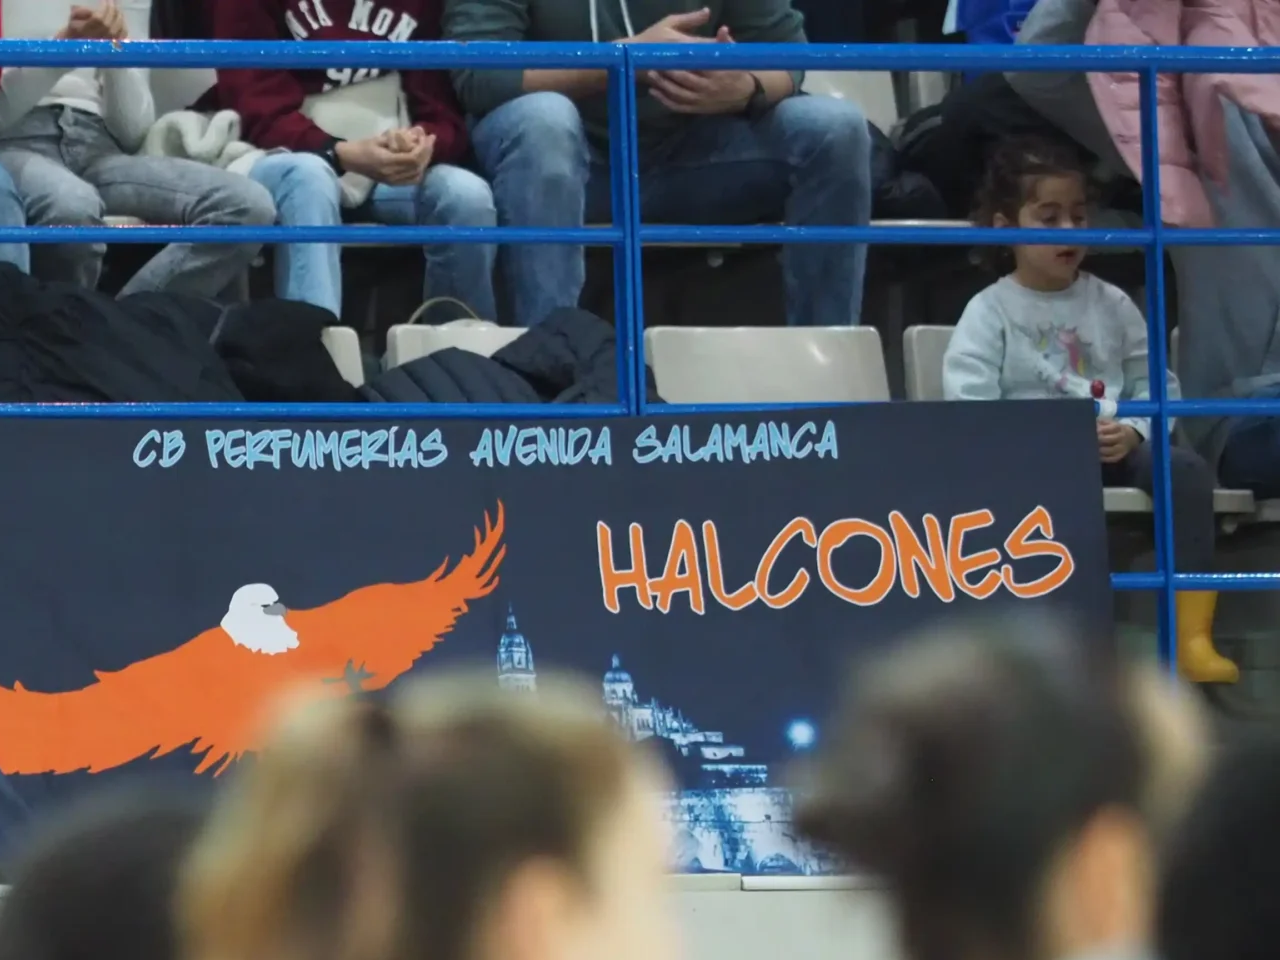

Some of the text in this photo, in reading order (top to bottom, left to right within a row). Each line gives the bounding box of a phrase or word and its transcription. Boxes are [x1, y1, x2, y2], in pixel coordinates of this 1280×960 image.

[132, 420, 838, 472] CB PERFUMERÍAS AVENIDA SALAMANCA
[596, 505, 1074, 615] HALCONES
